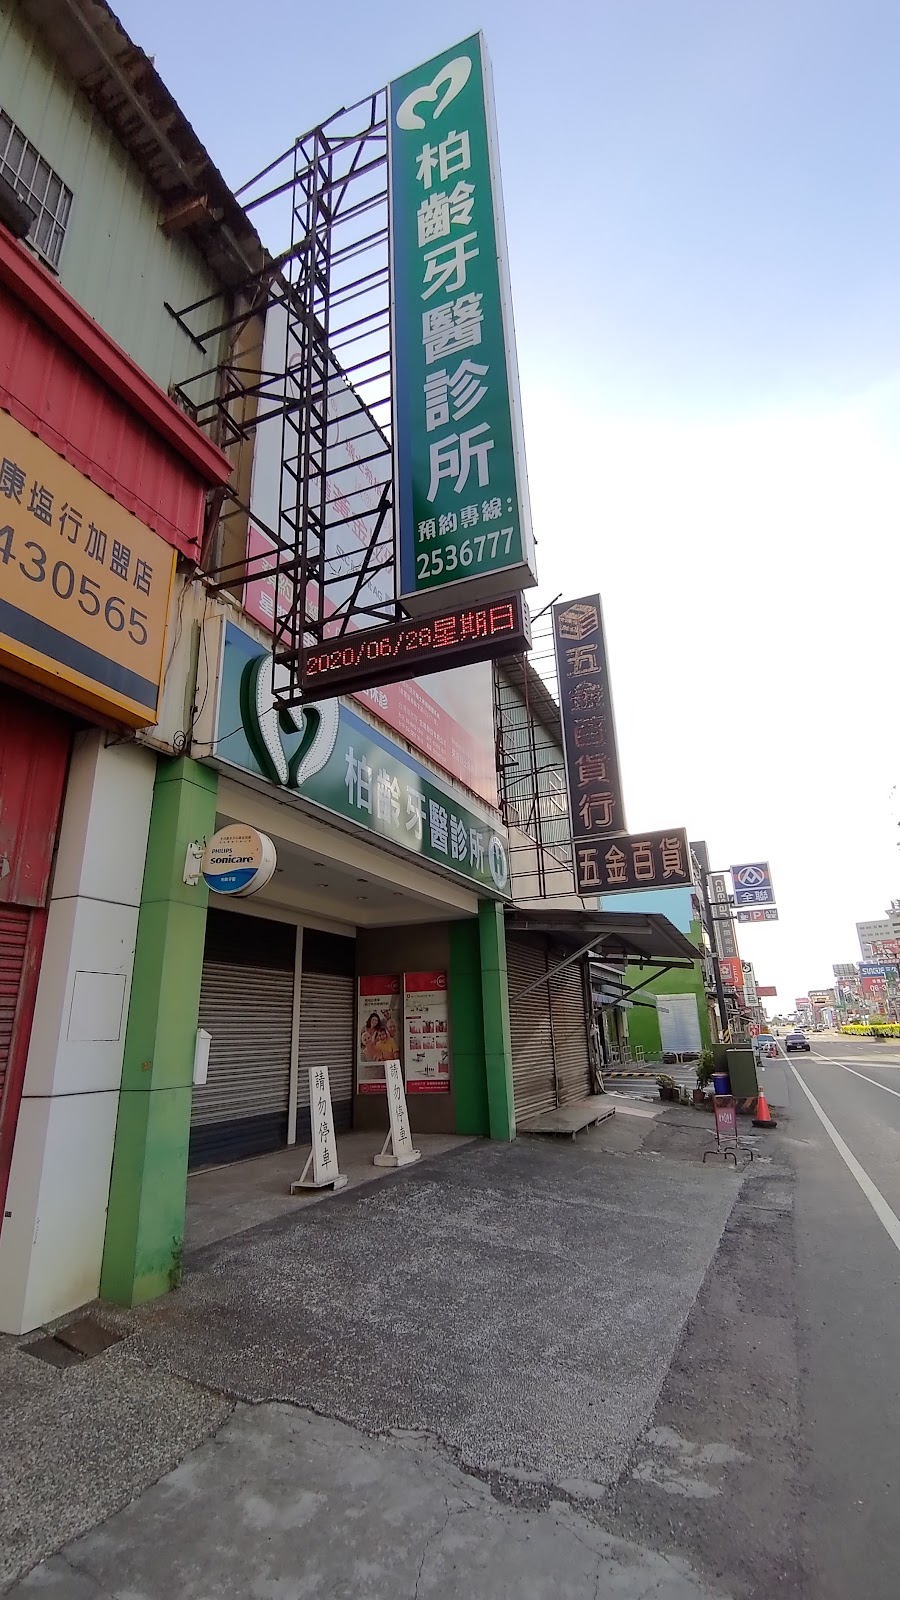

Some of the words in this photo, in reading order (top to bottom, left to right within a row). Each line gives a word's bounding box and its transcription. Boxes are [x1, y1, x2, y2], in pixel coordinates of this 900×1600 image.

[415, 129, 495, 503] 柏齡牙醫診所
[416, 527, 514, 580] 2536777
[345, 746, 484, 874] 柏齡牙醫診所
[210, 855, 253, 864] sonicare
[577, 836, 686, 887] 五金百貨
[740, 889, 769, 903] 全聯
[314, 1070, 332, 1170] 請勿停車
[389, 1062, 408, 1146] 請勿停車
